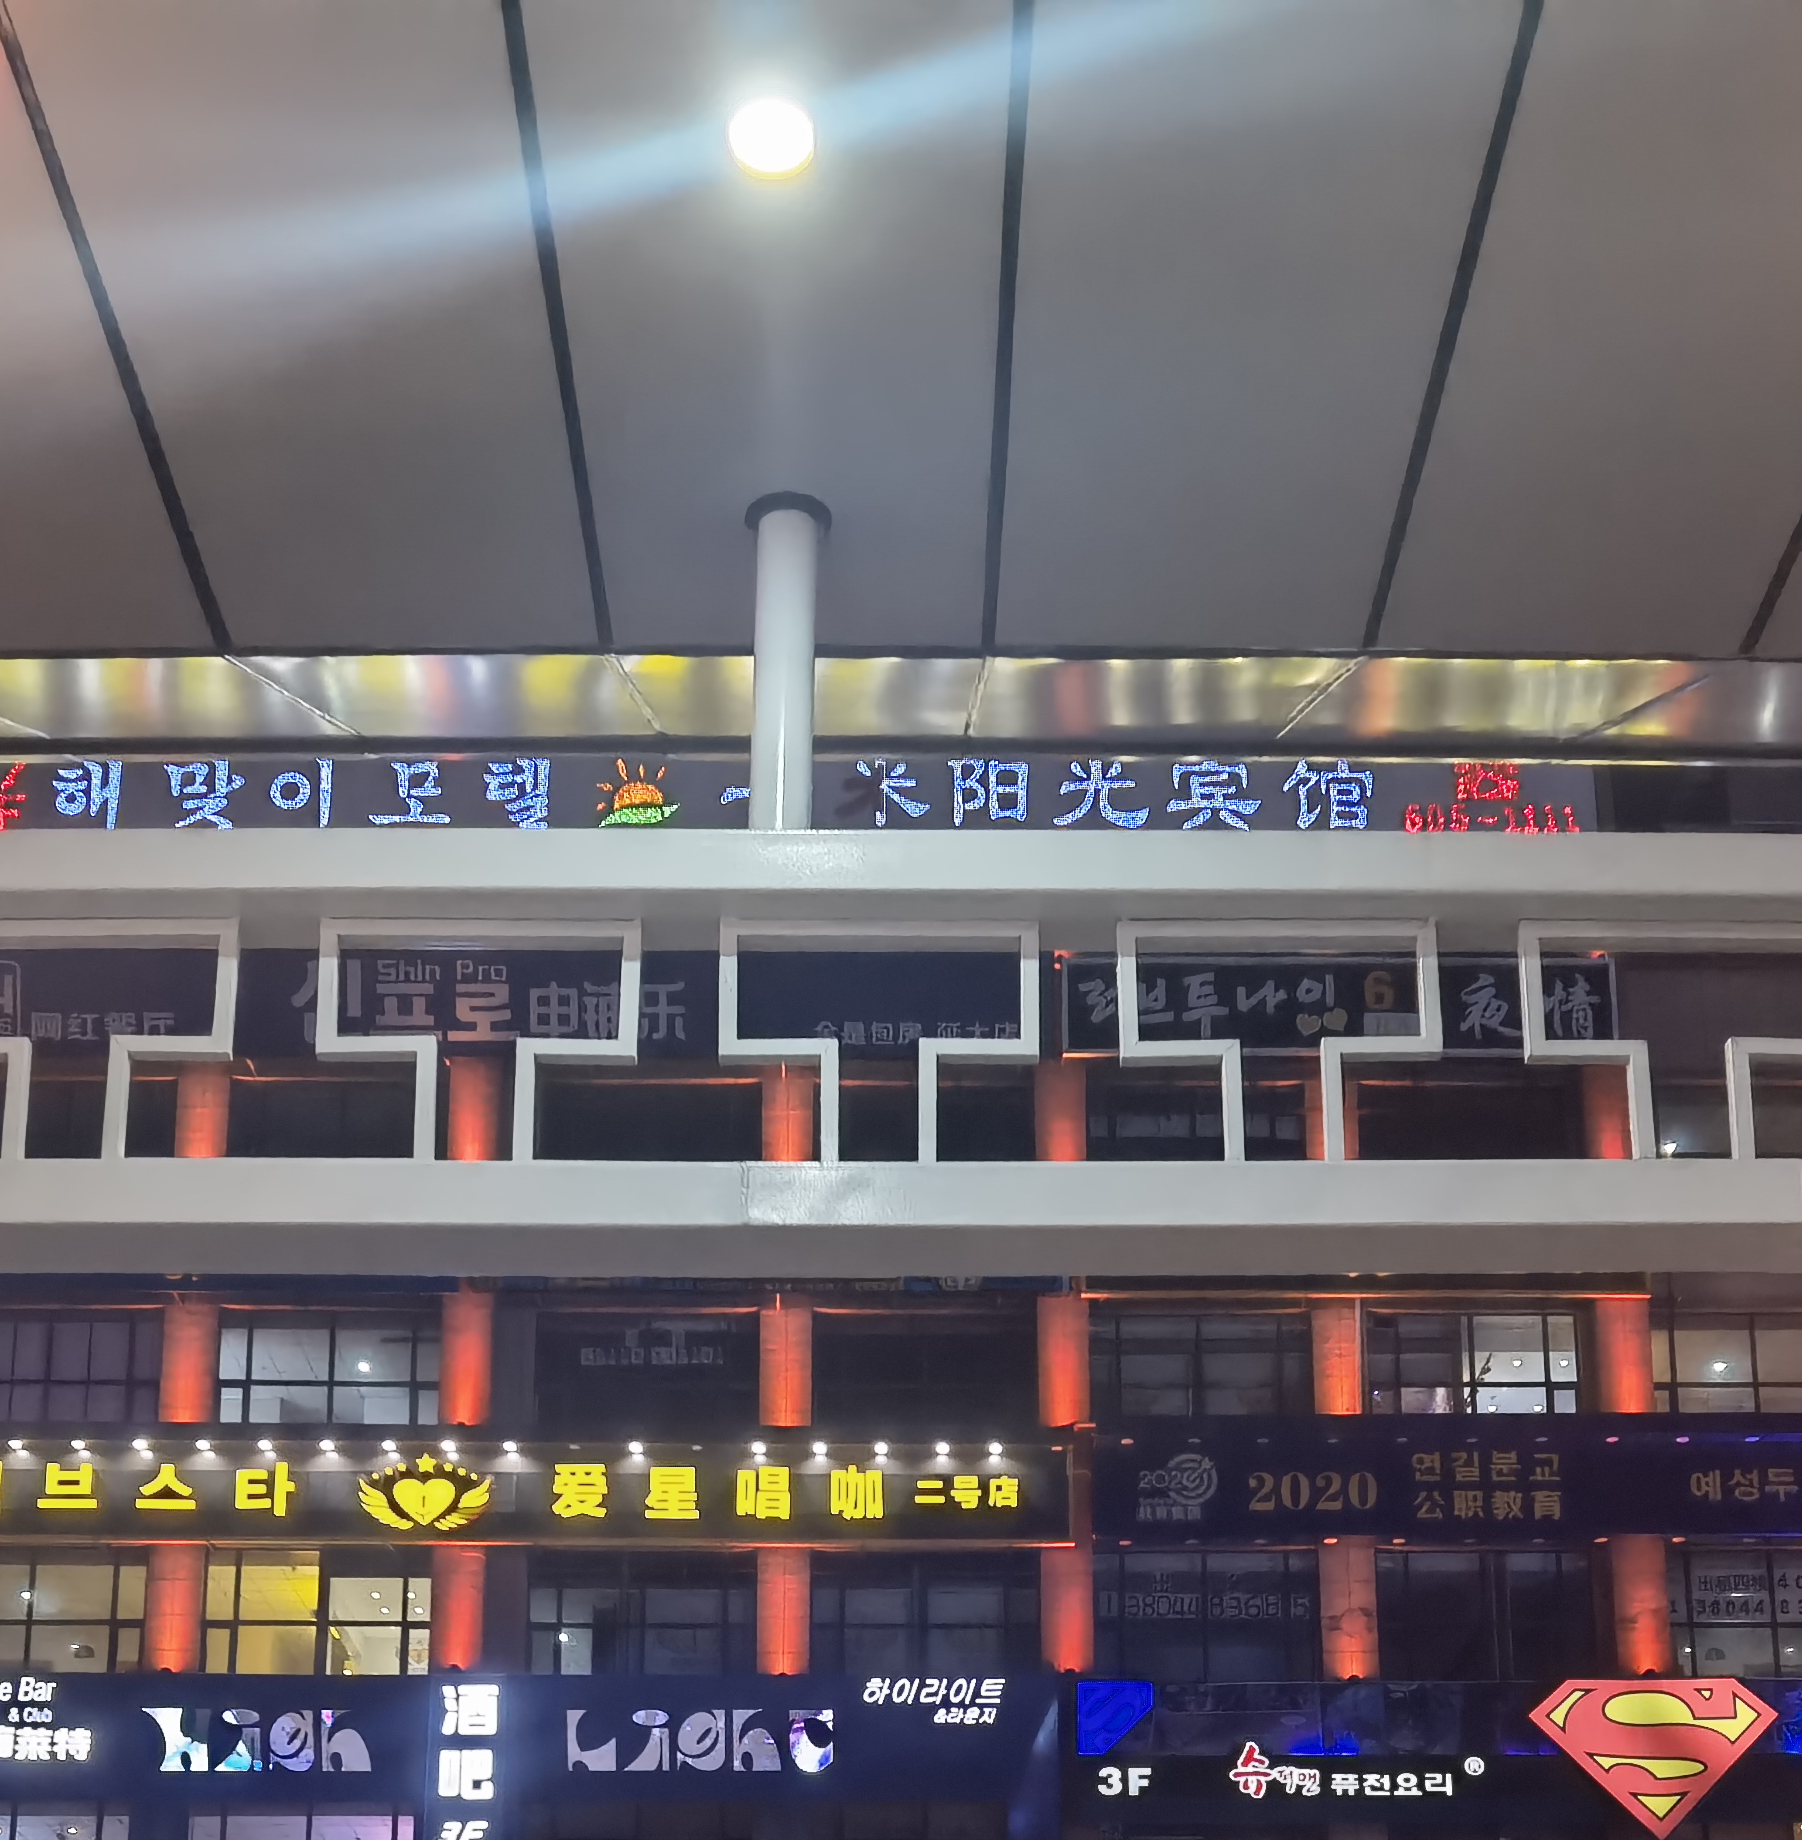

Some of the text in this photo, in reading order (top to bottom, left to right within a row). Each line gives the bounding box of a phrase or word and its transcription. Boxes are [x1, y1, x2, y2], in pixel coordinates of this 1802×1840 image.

[456, 960, 507, 981] Pro
[551, 1463, 1020, 1520] 爱星唱咖 二号店
[1248, 1472, 1378, 1511] 2020
[18, 1676, 57, 1701] Bar
[863, 1677, 1005, 1705] 하이라이트
[23, 1707, 53, 1722] Club
[438, 1683, 500, 1801] 酒吧
[1098, 1768, 1151, 1796] 3F
[1331, 1773, 1453, 1797] 퓨전요리
